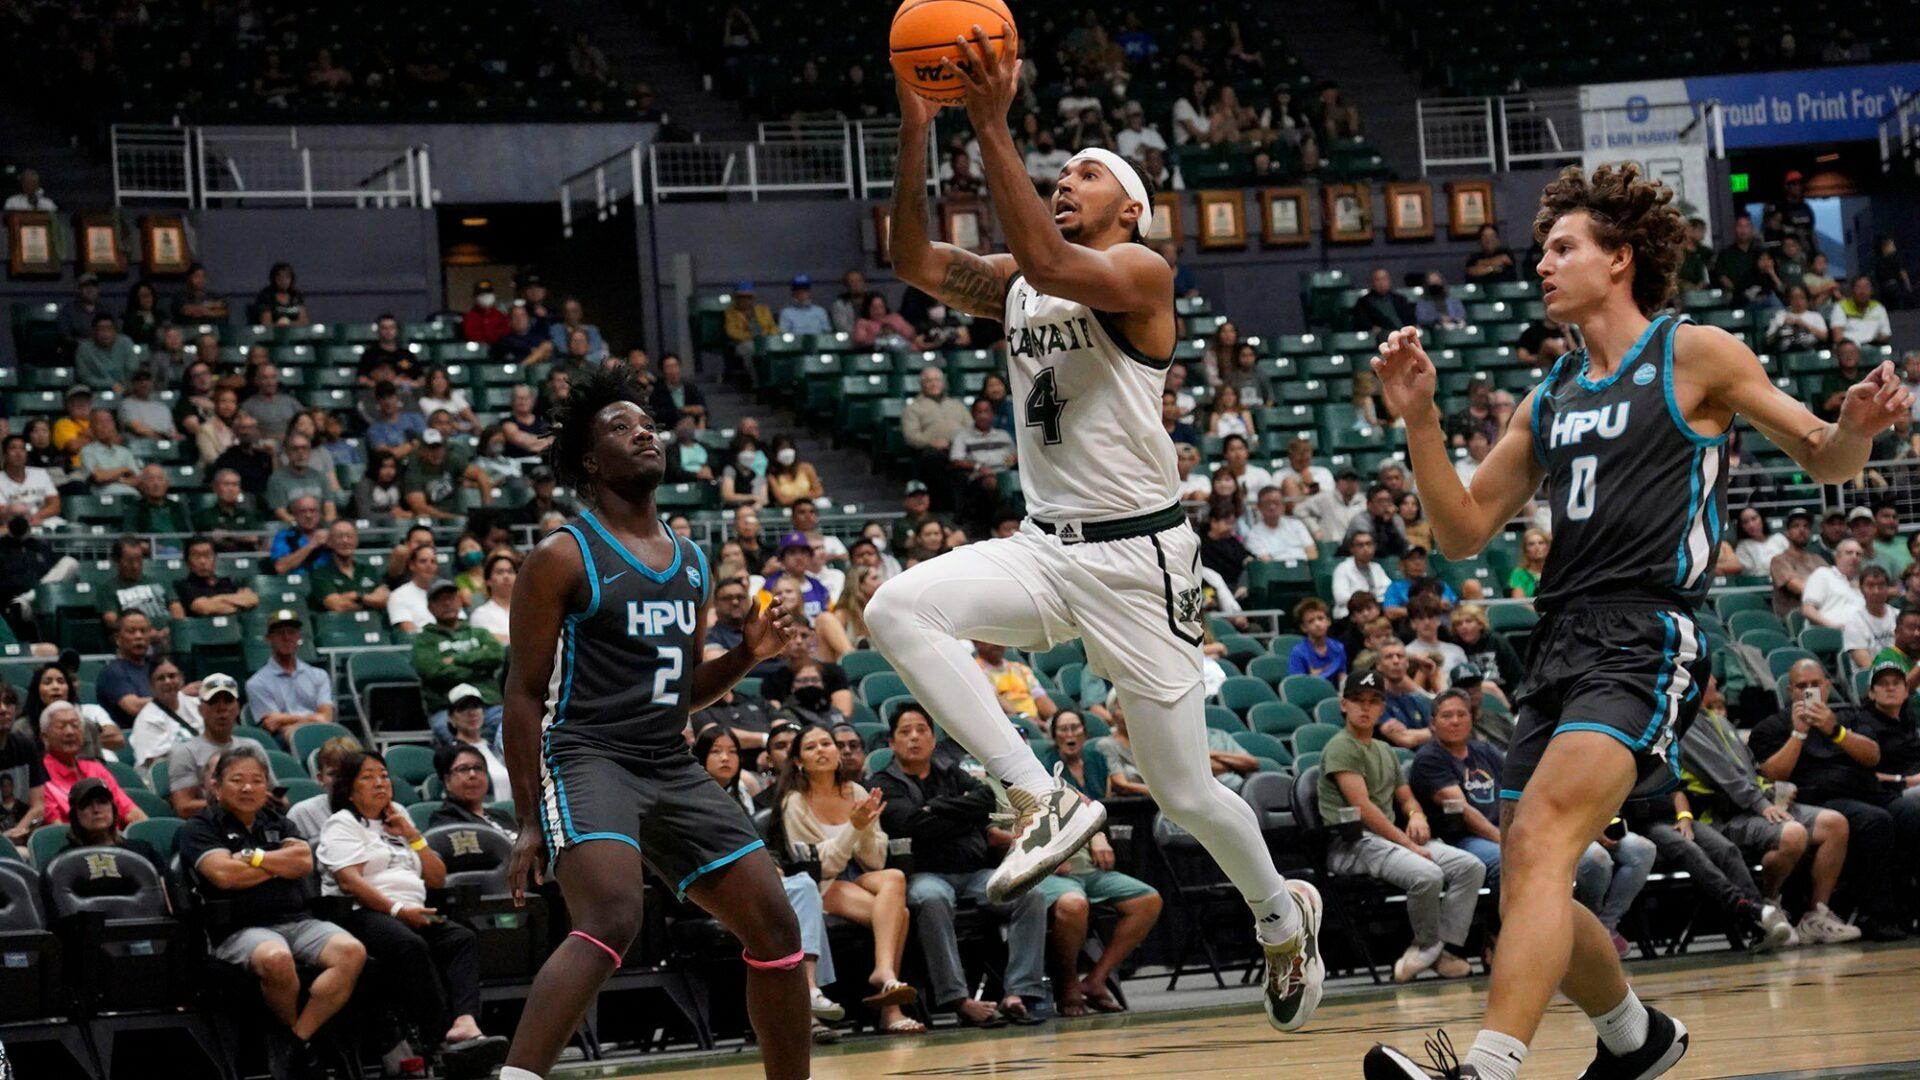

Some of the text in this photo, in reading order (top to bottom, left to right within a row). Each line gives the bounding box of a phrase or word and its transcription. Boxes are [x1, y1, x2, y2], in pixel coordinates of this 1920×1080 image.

[1772, 96, 1792, 124] to
[1798, 91, 1847, 122] Print
[1852, 88, 1886, 119] For
[1025, 366, 1068, 445] 4
[1550, 400, 1631, 449] HPU
[1566, 454, 1598, 521] 0
[626, 600, 697, 636] HPU
[651, 645, 684, 705] 2
[447, 829, 484, 857] H
[83, 853, 122, 880] H
